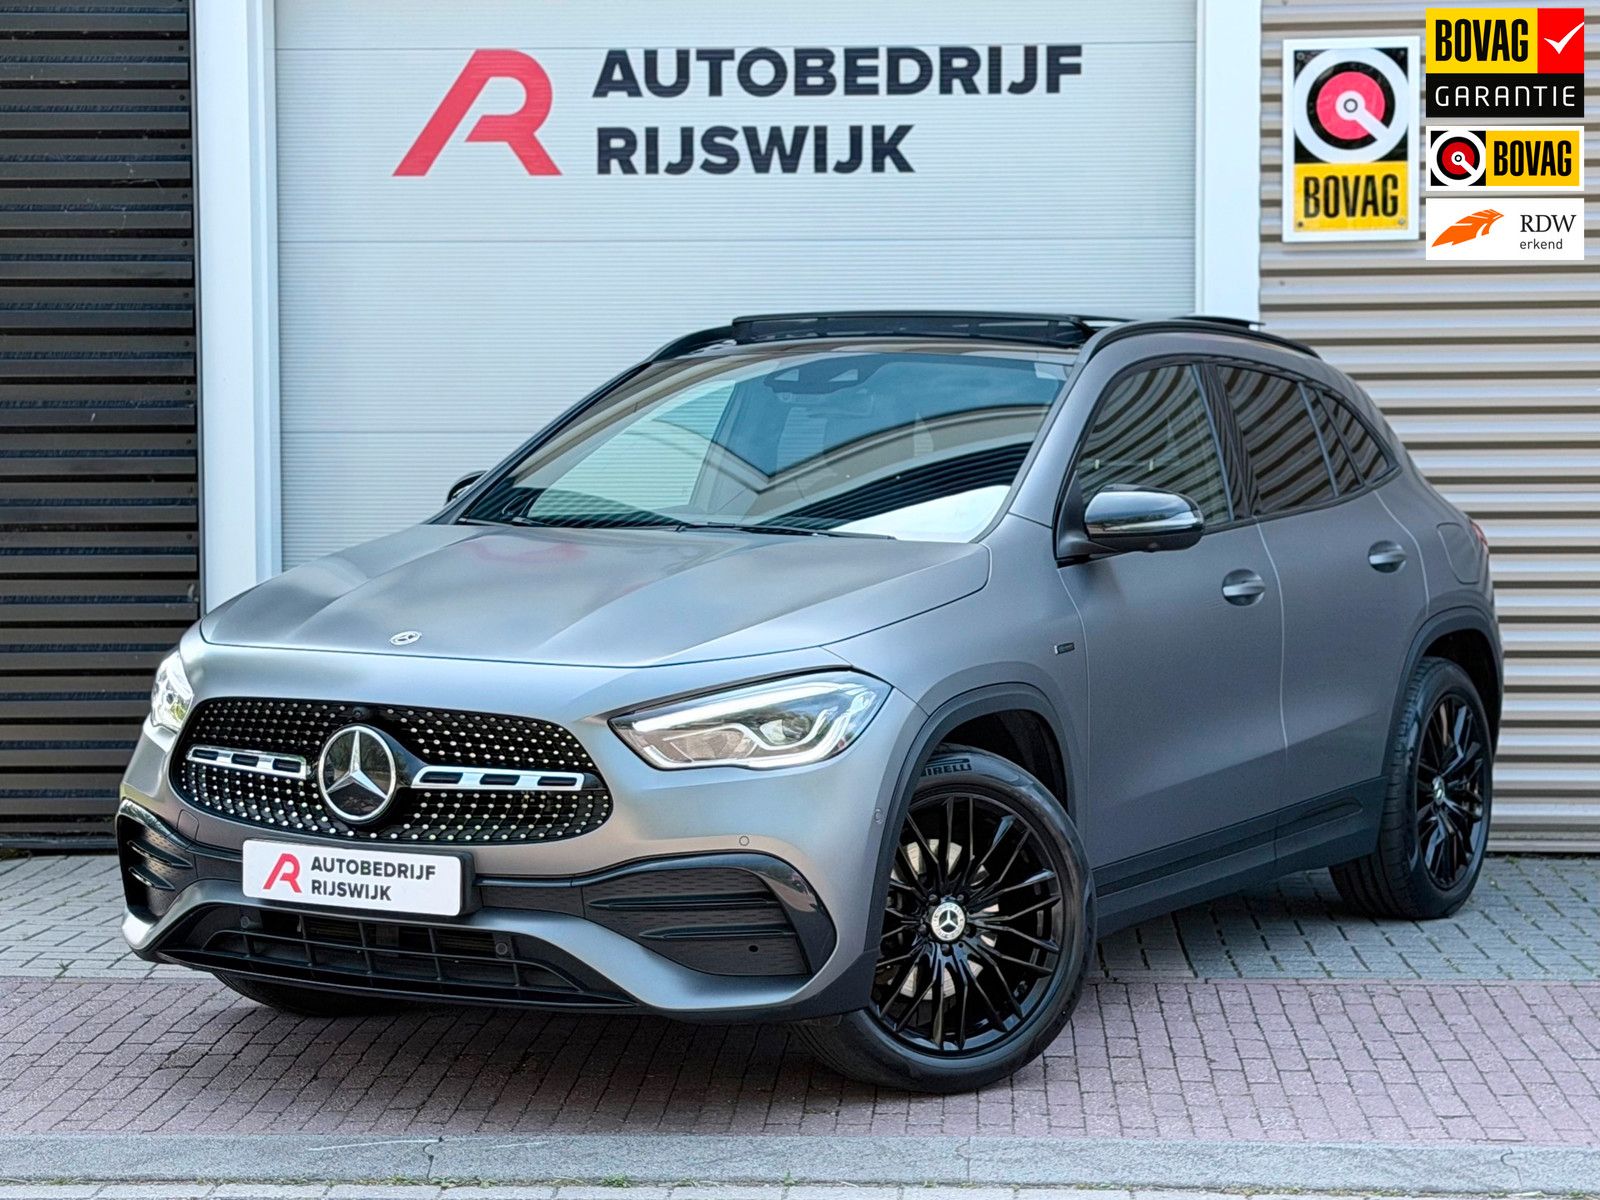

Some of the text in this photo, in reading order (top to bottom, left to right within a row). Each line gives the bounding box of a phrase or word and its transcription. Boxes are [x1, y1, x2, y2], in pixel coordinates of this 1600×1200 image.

[593, 45, 1081, 98] AUTOBEDRIJF
[597, 124, 914, 175] RIJSWIJK
[1303, 174, 1399, 218] BOVAG
[311, 856, 436, 880] AUTOBEDRIJF
[311, 879, 392, 901] RIJSWIJK
